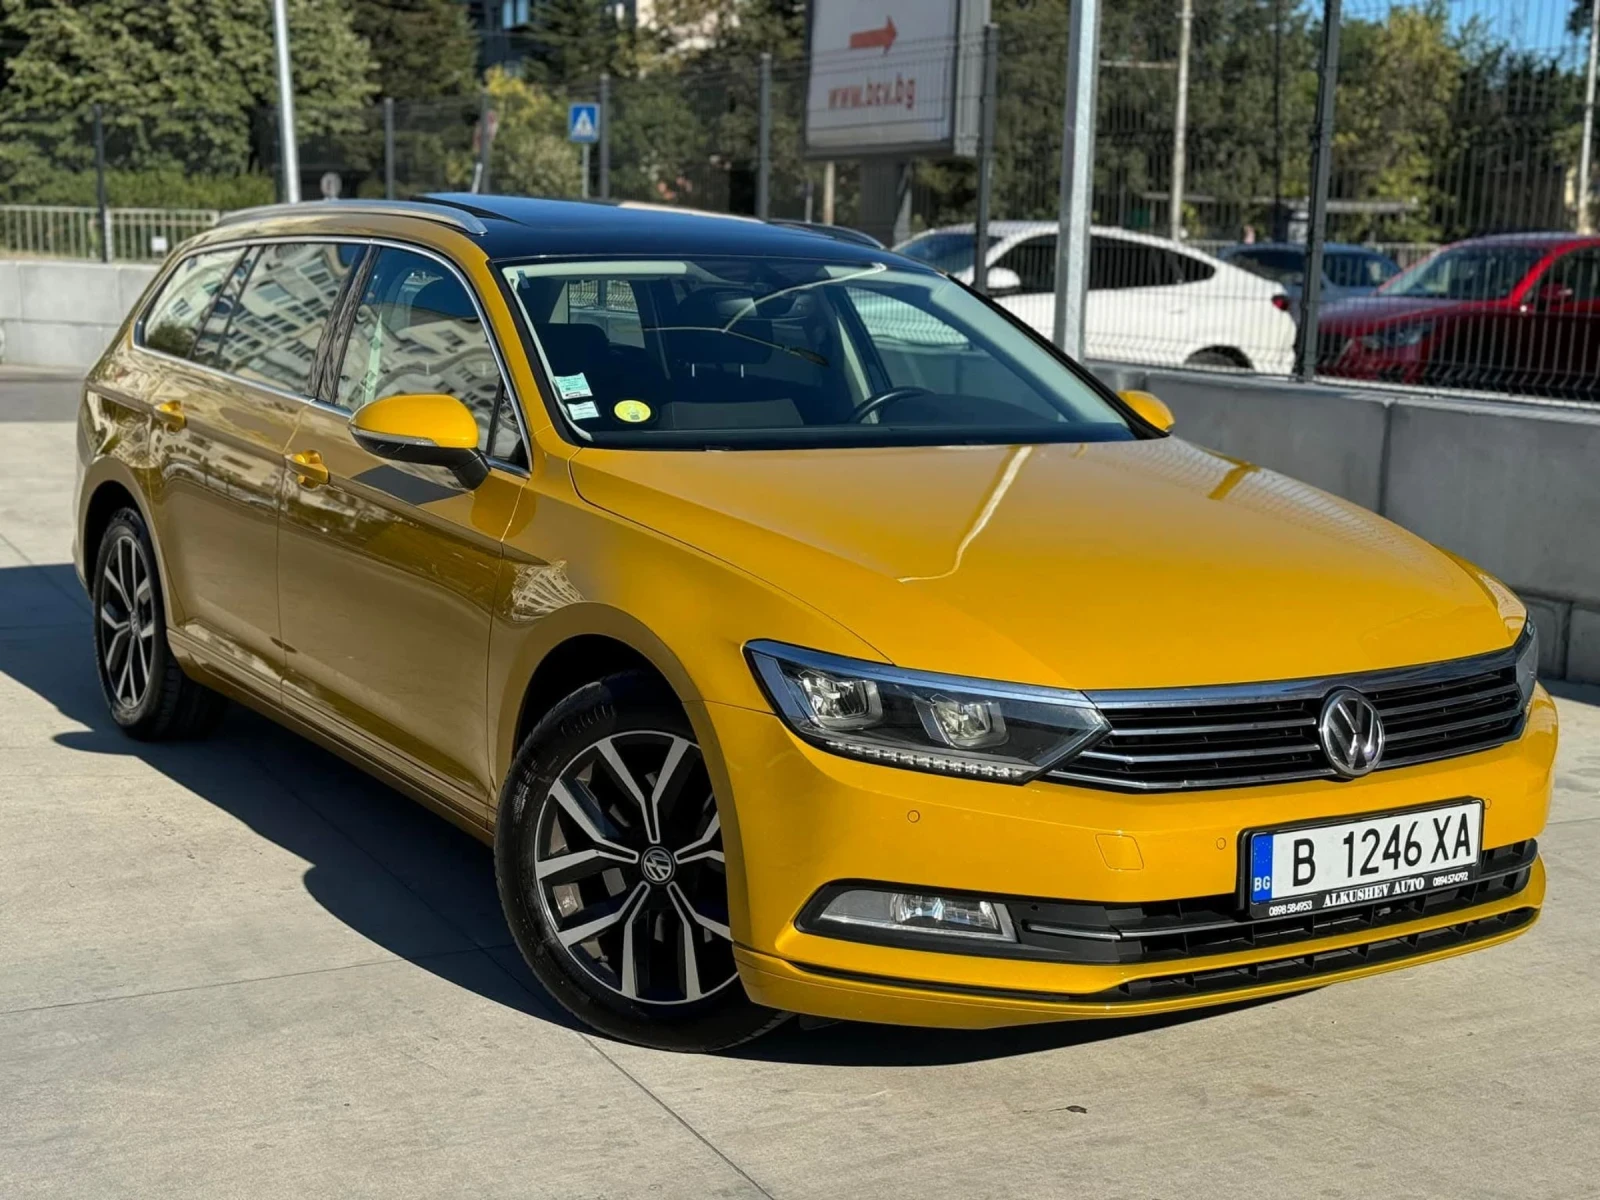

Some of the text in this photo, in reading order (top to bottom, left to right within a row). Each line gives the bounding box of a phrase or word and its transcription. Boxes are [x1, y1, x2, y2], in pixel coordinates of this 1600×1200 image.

[1292, 812, 1471, 887] B 1246 XA
[1254, 875, 1271, 891] BG
[1322, 883, 1390, 908] ALKUSHEV
[1393, 877, 1425, 895] AUTO
